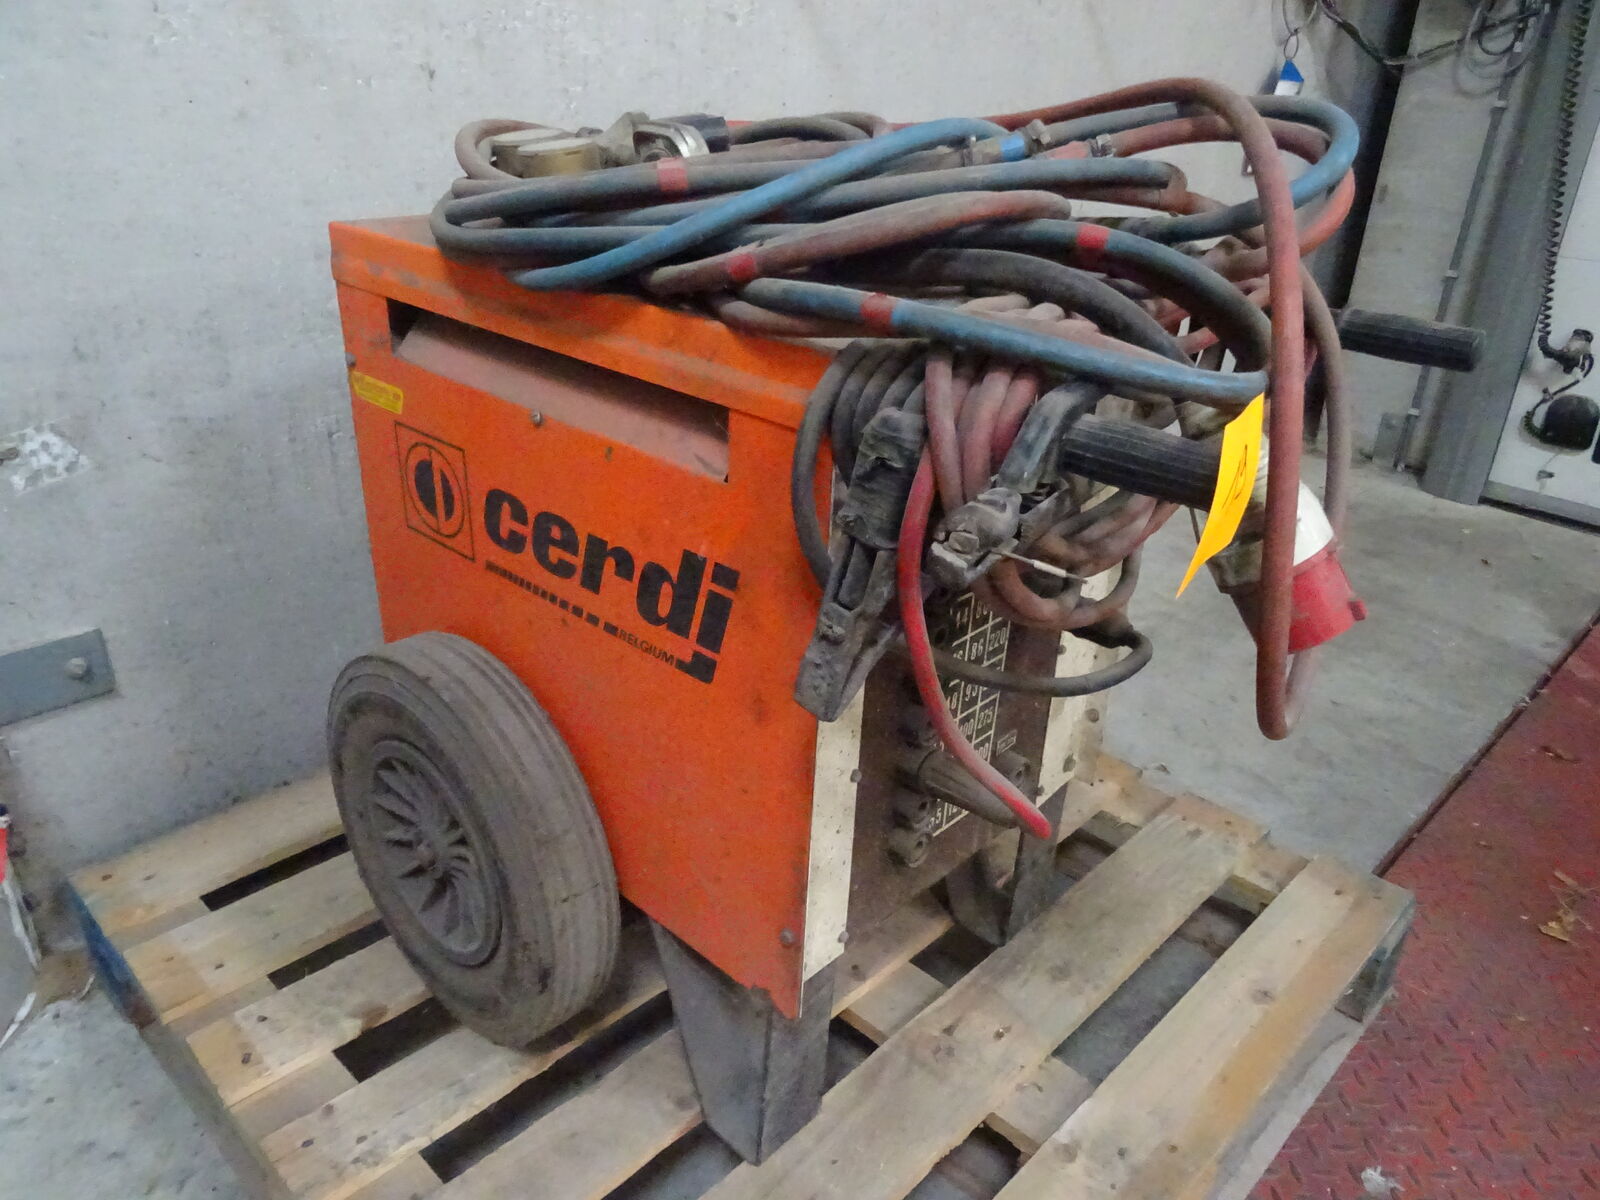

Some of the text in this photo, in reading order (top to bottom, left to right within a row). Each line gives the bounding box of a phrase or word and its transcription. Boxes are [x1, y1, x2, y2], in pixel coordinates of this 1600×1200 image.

[484, 488, 741, 655] cerdi
[618, 627, 675, 667] BELGIUM
[970, 638, 985, 660] 86
[988, 627, 1007, 651] 220
[977, 706, 993, 729] 275
